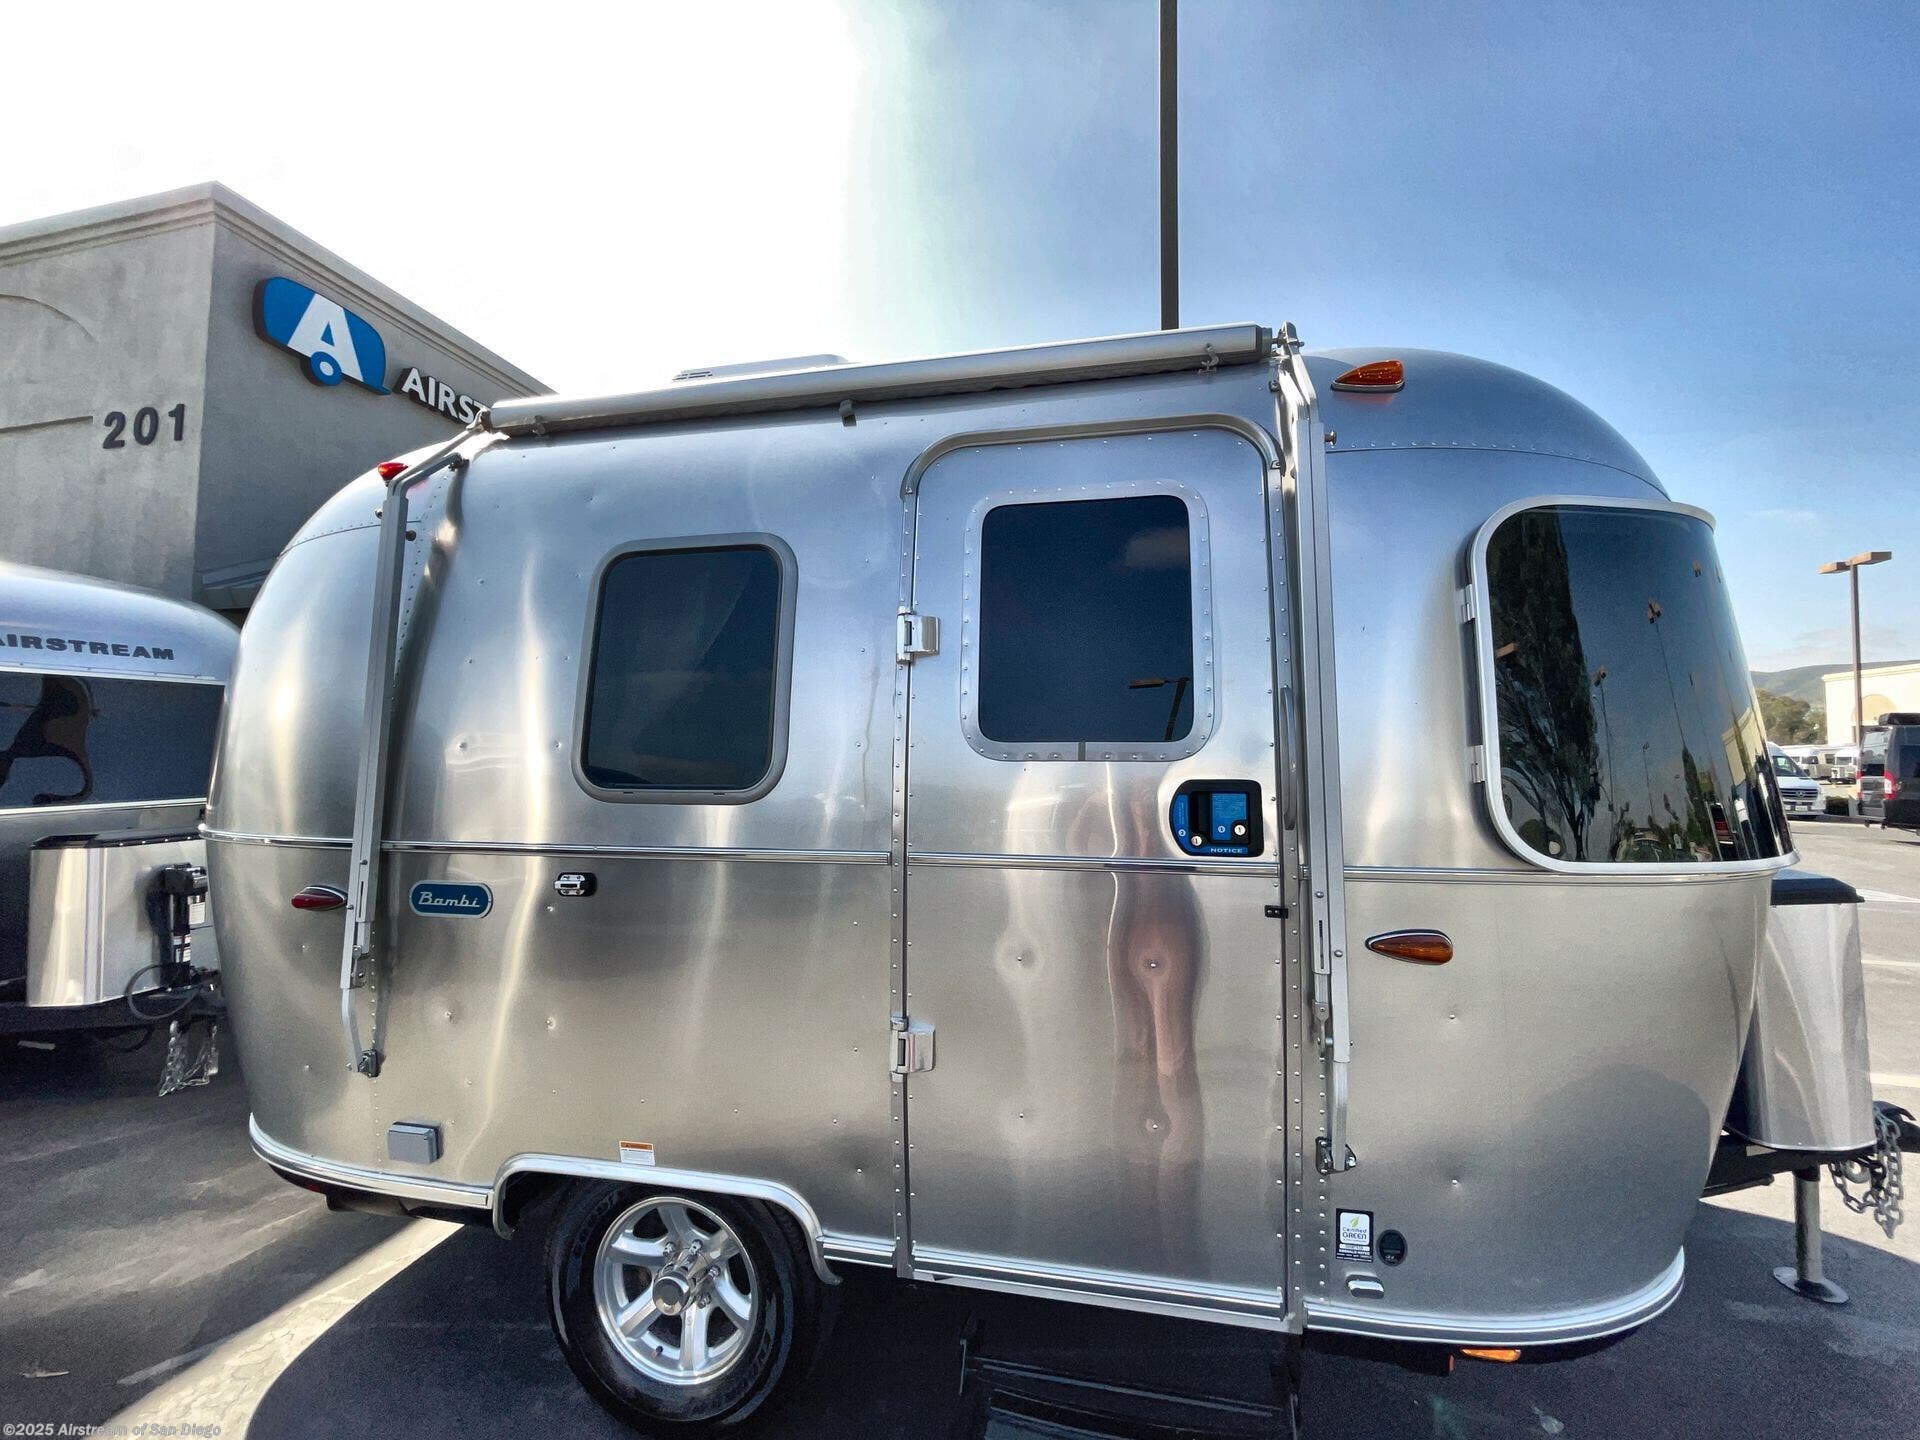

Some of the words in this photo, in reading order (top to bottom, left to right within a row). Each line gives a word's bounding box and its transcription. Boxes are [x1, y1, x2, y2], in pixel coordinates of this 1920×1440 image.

[287, 293, 364, 382] A
[103, 404, 185, 449] 201
[0, 634, 174, 660] IRSTREAM
[418, 891, 480, 908] Bambi
